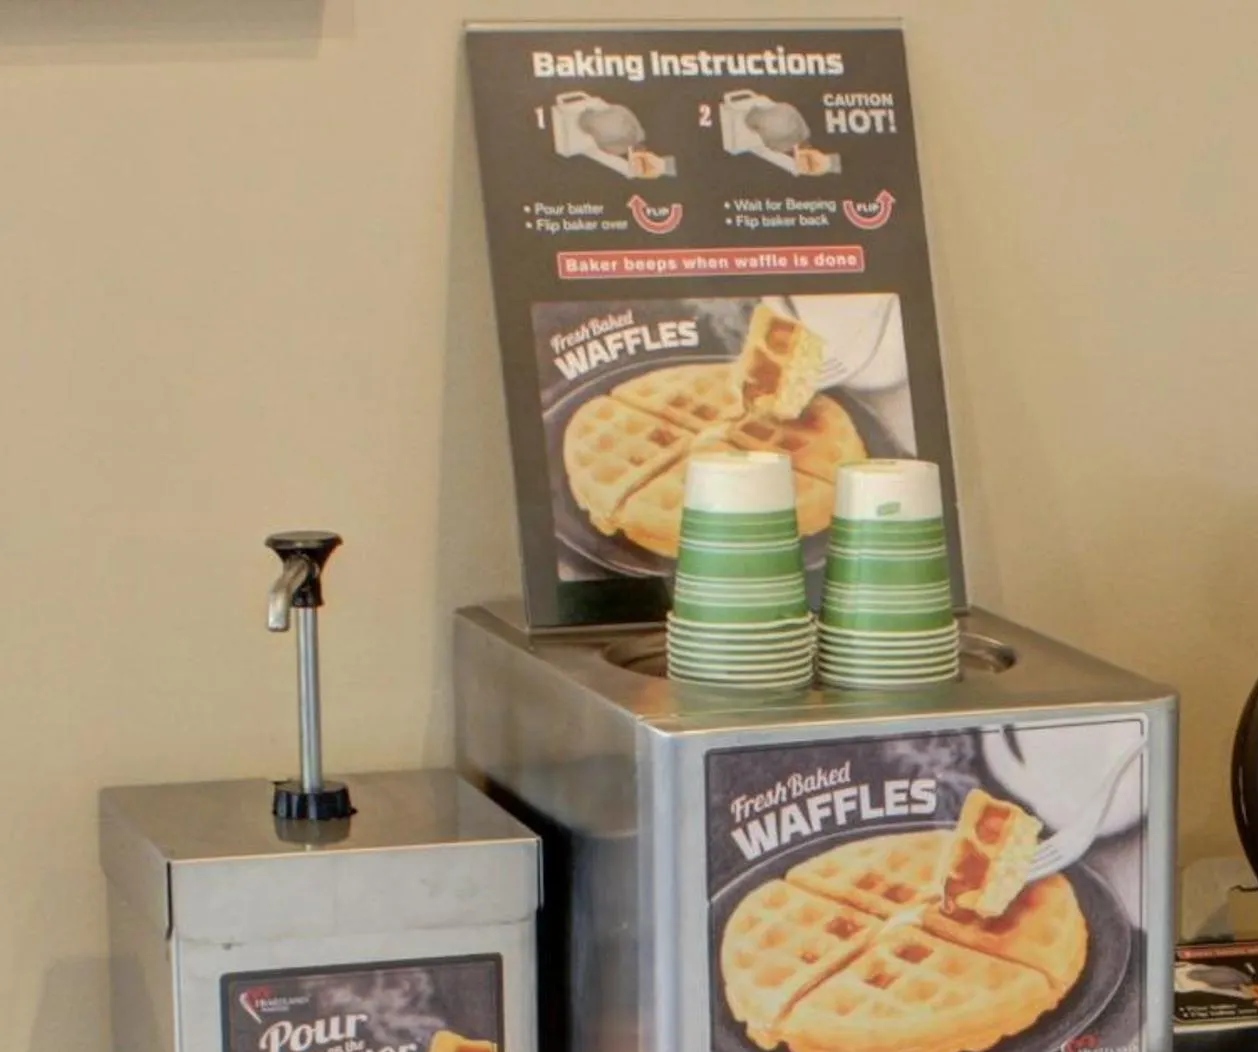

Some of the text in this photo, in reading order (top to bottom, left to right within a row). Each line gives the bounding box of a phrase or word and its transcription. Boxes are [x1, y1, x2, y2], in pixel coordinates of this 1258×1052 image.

[532, 46, 845, 81] Baking Instructions
[822, 94, 894, 107] CAUTION
[534, 107, 546, 130] 1
[700, 105, 713, 127] 2
[825, 108, 898, 134] HOT!
[534, 202, 605, 216] Pour batter
[734, 197, 837, 213] Wait for Beeping
[535, 218, 629, 234] Flip baker over
[735, 213, 830, 230] Flip baker back
[565, 251, 858, 273] Baker beeps when waffle is done
[550, 322, 591, 354] Fresh
[553, 320, 700, 381] WAFFLES
[730, 760, 852, 824] Fresh Baked
[730, 778, 937, 862] WAFFLES
